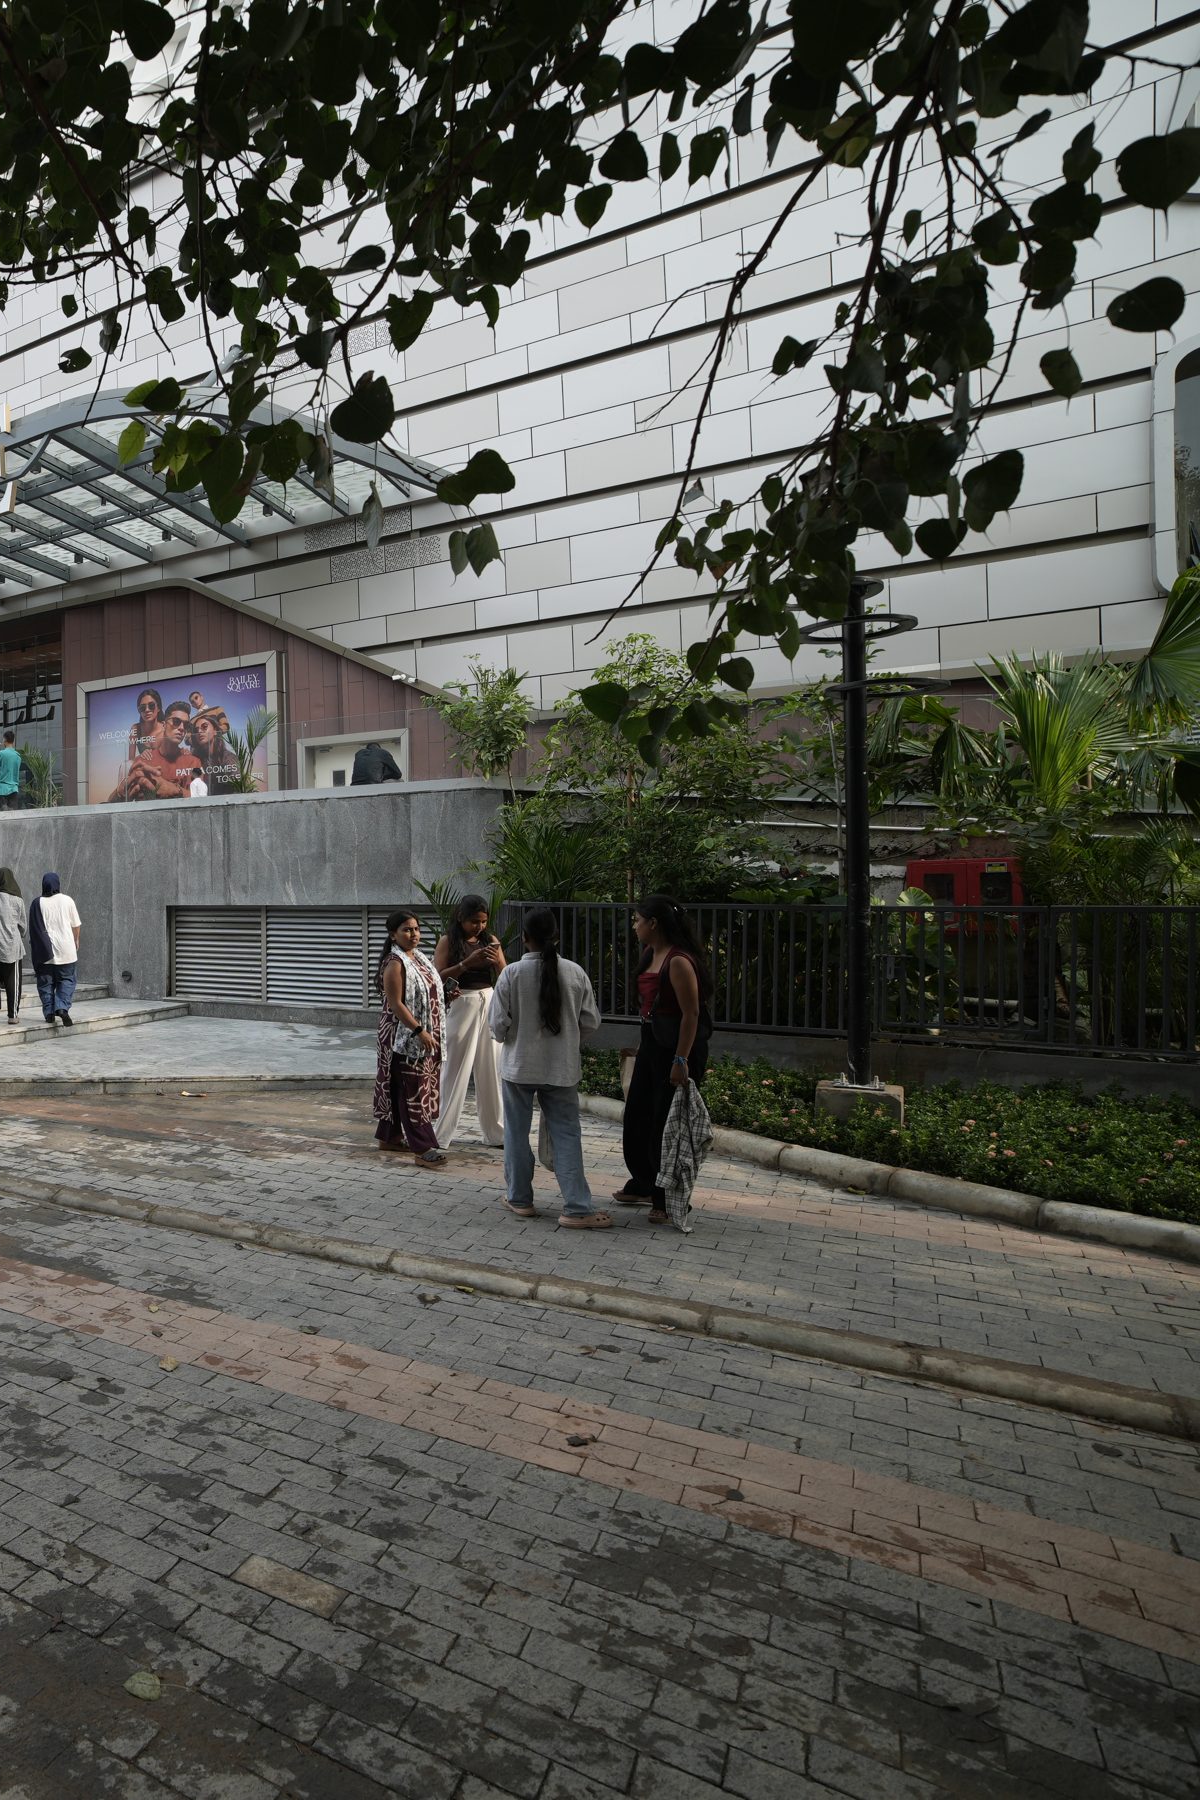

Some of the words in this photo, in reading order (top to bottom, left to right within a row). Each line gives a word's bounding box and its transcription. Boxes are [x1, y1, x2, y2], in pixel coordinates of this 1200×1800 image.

[227, 679, 261, 692] SQUARE
[229, 673, 259, 686] BAILEY
[99, 728, 138, 740] WELCOME
[129, 735, 156, 745] WHERE
[205, 763, 238, 775] COMES
[216, 772, 264, 784] TOGEER
